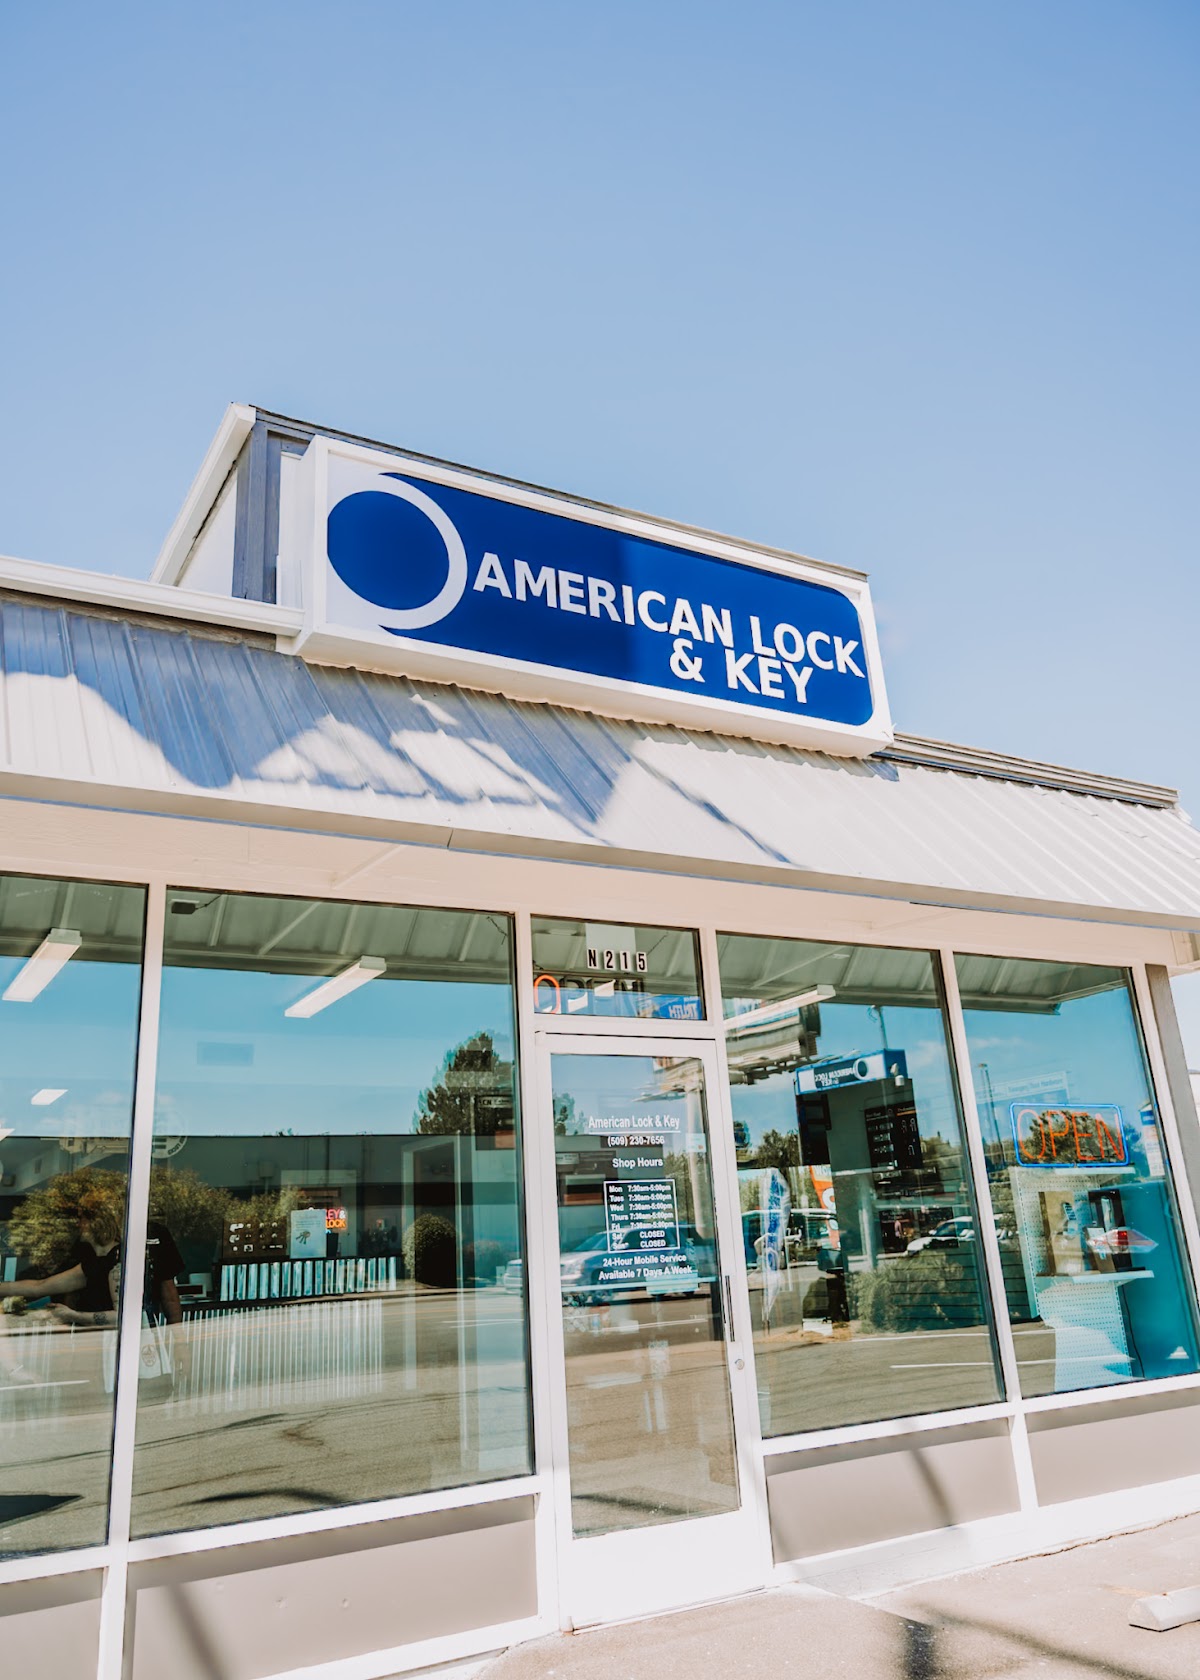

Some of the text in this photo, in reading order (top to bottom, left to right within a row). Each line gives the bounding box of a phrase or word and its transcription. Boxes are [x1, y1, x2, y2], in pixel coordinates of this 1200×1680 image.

[473, 553, 866, 678] AMERICAN LOCK
[669, 639, 813, 703] & KEY
[588, 1114, 680, 1130] American Lock & Key
[1017, 1109, 1125, 1160] OPEN
[607, 1135, 665, 1147] (509) 230-7656
[612, 1157, 664, 1169] Shop Hours
[609, 1185, 623, 1193] Mon
[609, 1195, 624, 1203] Tues
[609, 1204, 624, 1212] Wed
[610, 1213, 629, 1221] Thurs
[639, 1230, 665, 1239] CLOSED
[640, 1239, 666, 1249] CLOSED
[603, 1254, 687, 1268] 24-Hour Mobile Service
[598, 1265, 693, 1281] Available 7 Days A Week
